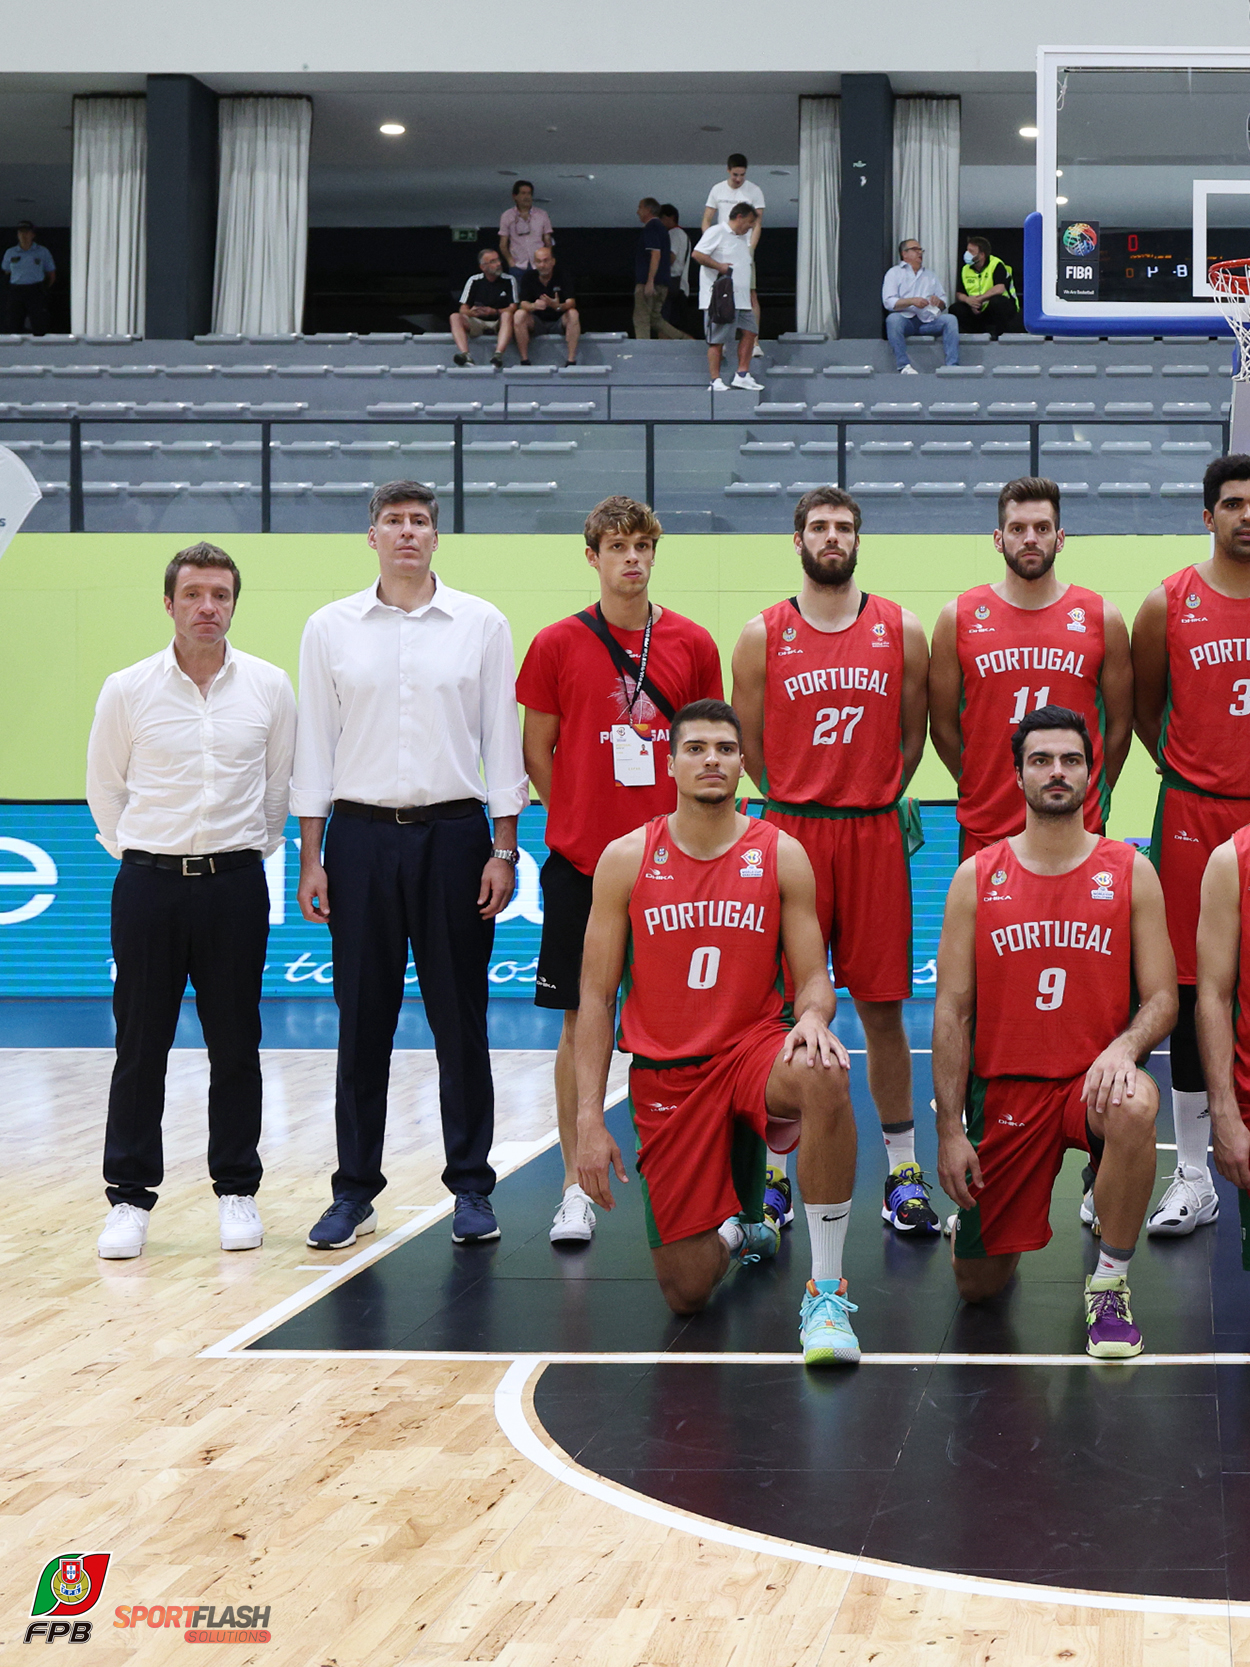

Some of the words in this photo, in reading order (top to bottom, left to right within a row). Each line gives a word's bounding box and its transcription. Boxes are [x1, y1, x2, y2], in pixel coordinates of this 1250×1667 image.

[1065, 265, 1093, 280] FIBA
[1181, 616, 1208, 624] DHIKA
[974, 646, 1085, 678] PORTUGAL
[783, 666, 889, 701] PORTUGAL
[1009, 686, 1050, 724] 11
[812, 705, 865, 746] 27
[645, 873, 674, 881] DHIKA
[643, 900, 765, 936] PORTUGAL
[990, 920, 1112, 957] PORTUGAL
[687, 946, 721, 990] 0
[1035, 967, 1067, 1011] 9
